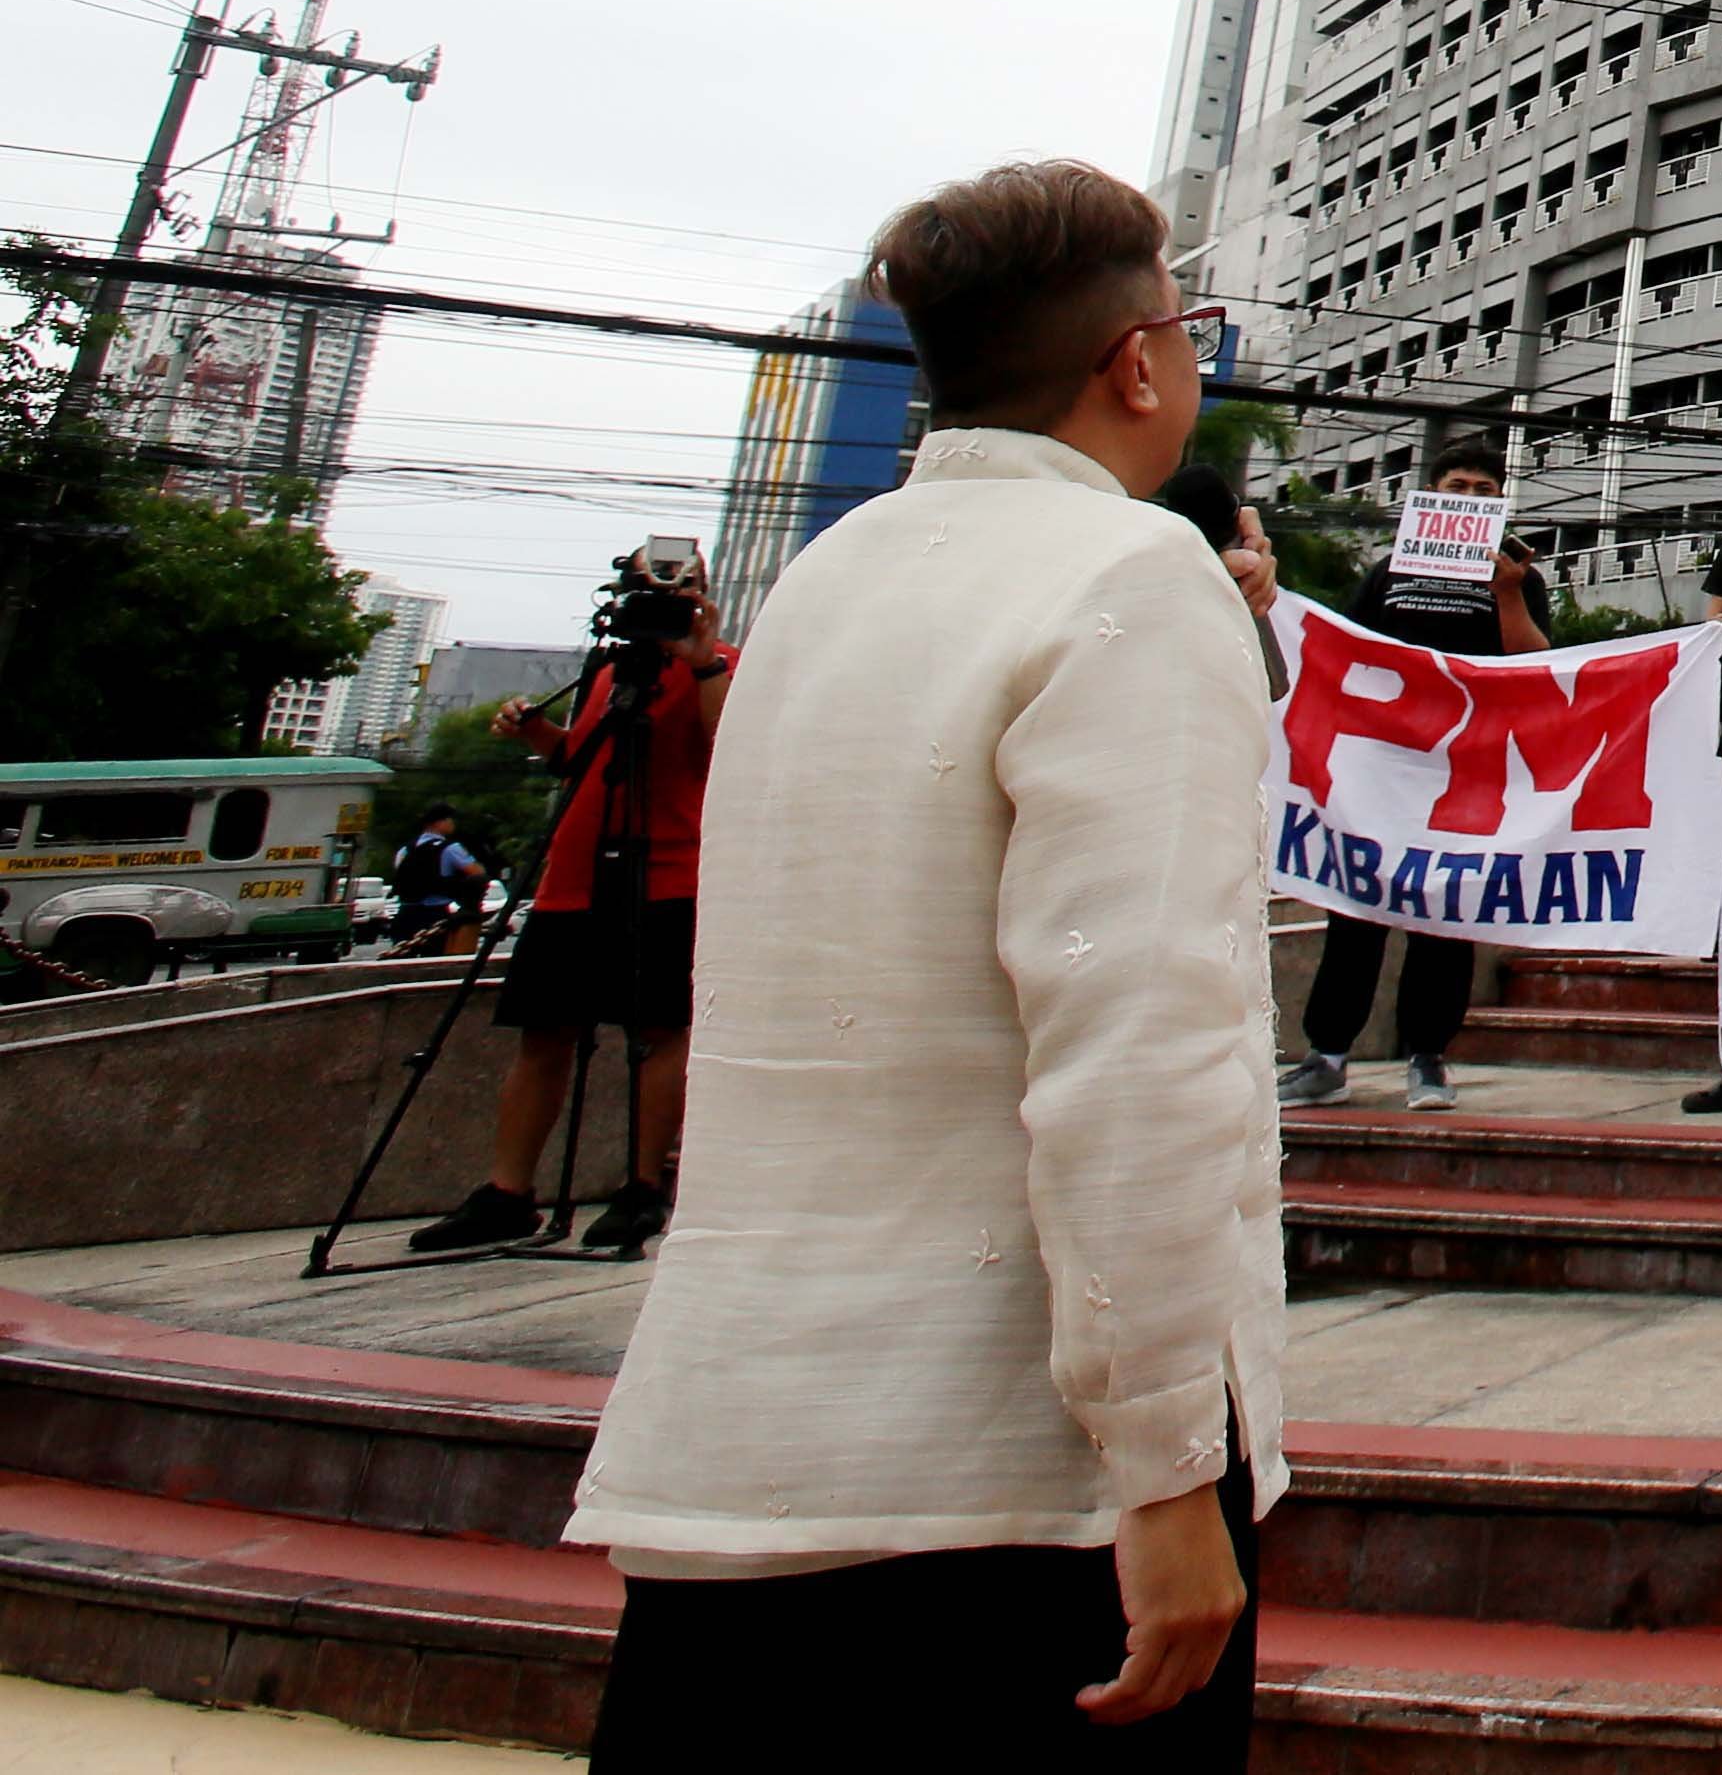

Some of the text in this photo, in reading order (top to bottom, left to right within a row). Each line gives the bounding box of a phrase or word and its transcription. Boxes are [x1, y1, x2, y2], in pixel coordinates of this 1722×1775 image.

[1416, 511, 1491, 544] TAKSIL
[1402, 539, 1420, 556] SA
[1423, 541, 1463, 560] WAGE
[1281, 611, 1680, 837] PM
[117, 851, 180, 867] WELCOME
[265, 846, 321, 861] FOR HIRE
[1276, 801, 1644, 926] KABATAAN
